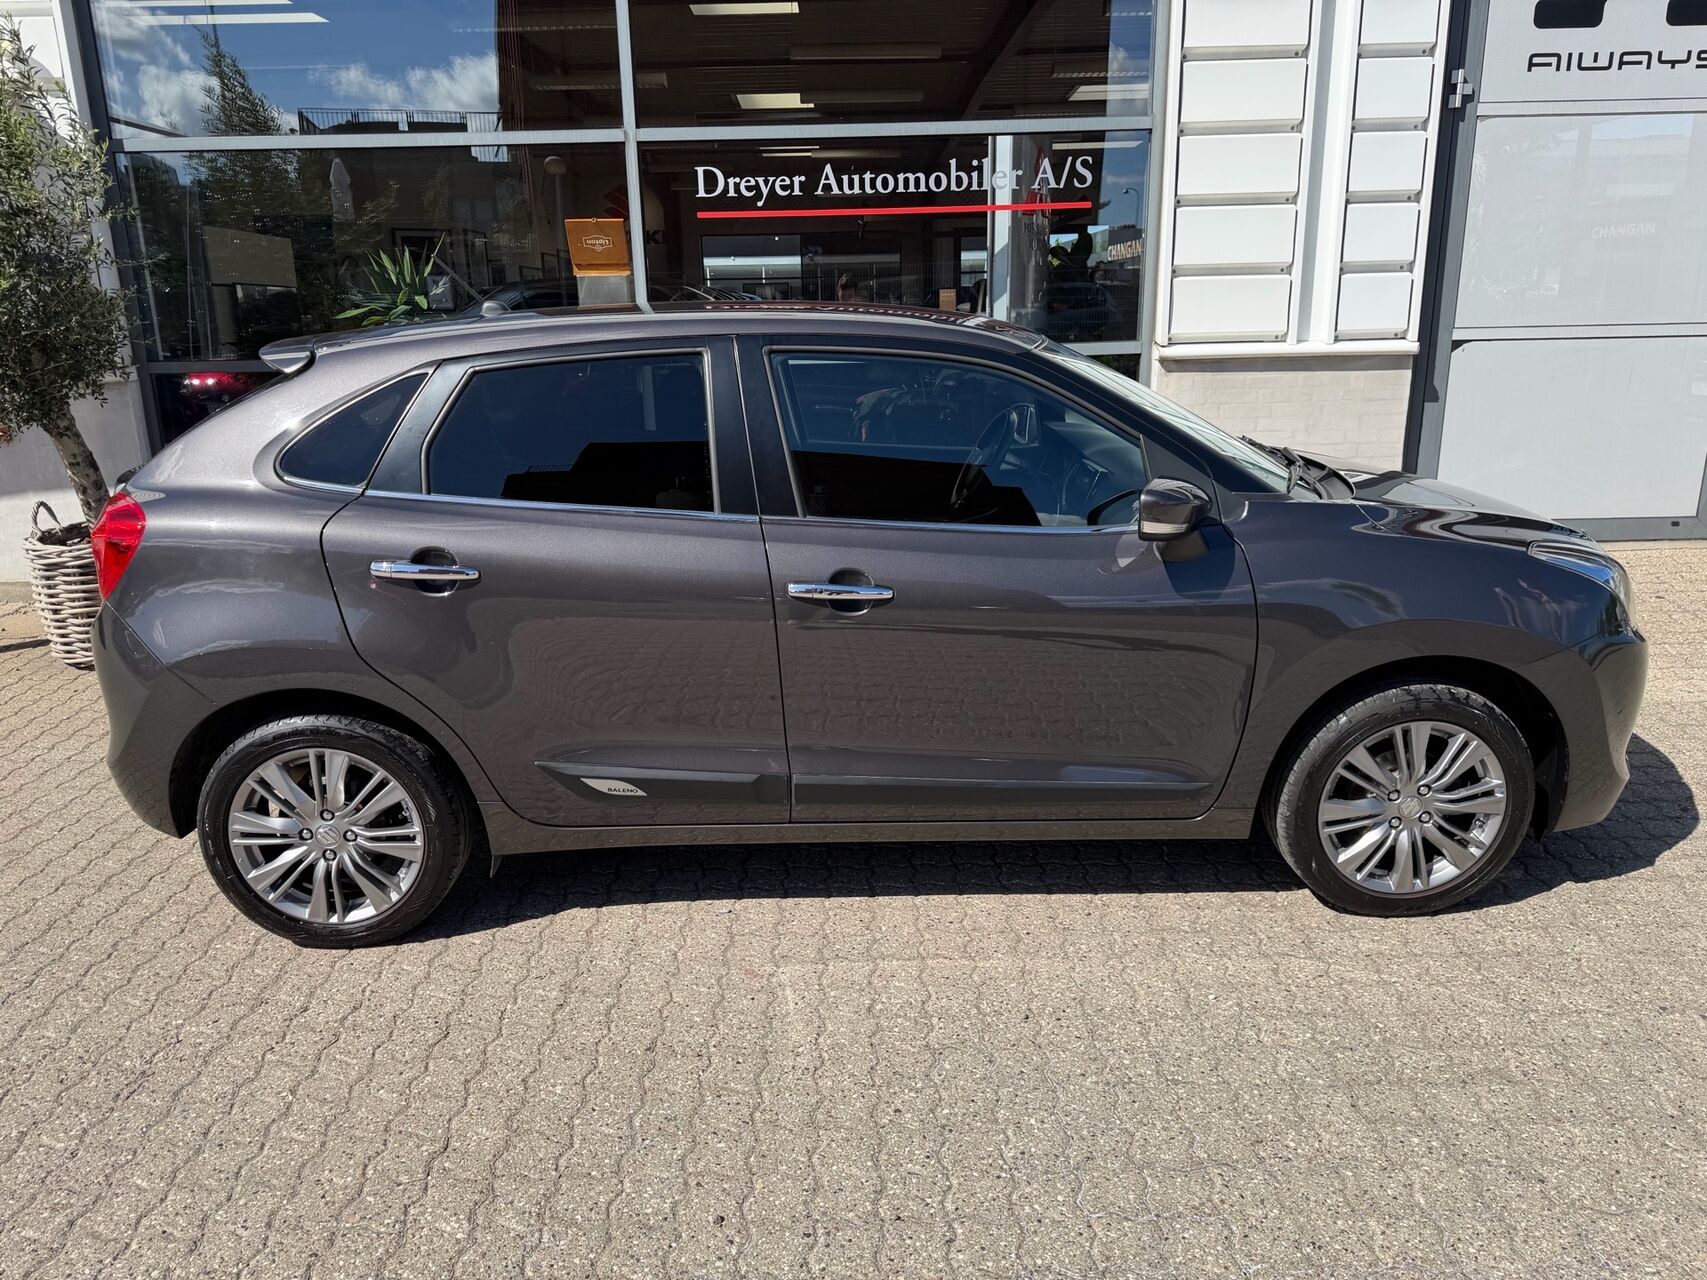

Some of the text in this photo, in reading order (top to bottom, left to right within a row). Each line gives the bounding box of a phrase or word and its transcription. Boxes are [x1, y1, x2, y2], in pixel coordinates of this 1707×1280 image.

[694, 156, 1093, 207] Dreyer Automobiler A/S
[1107, 239, 1143, 261] CHANGAN
